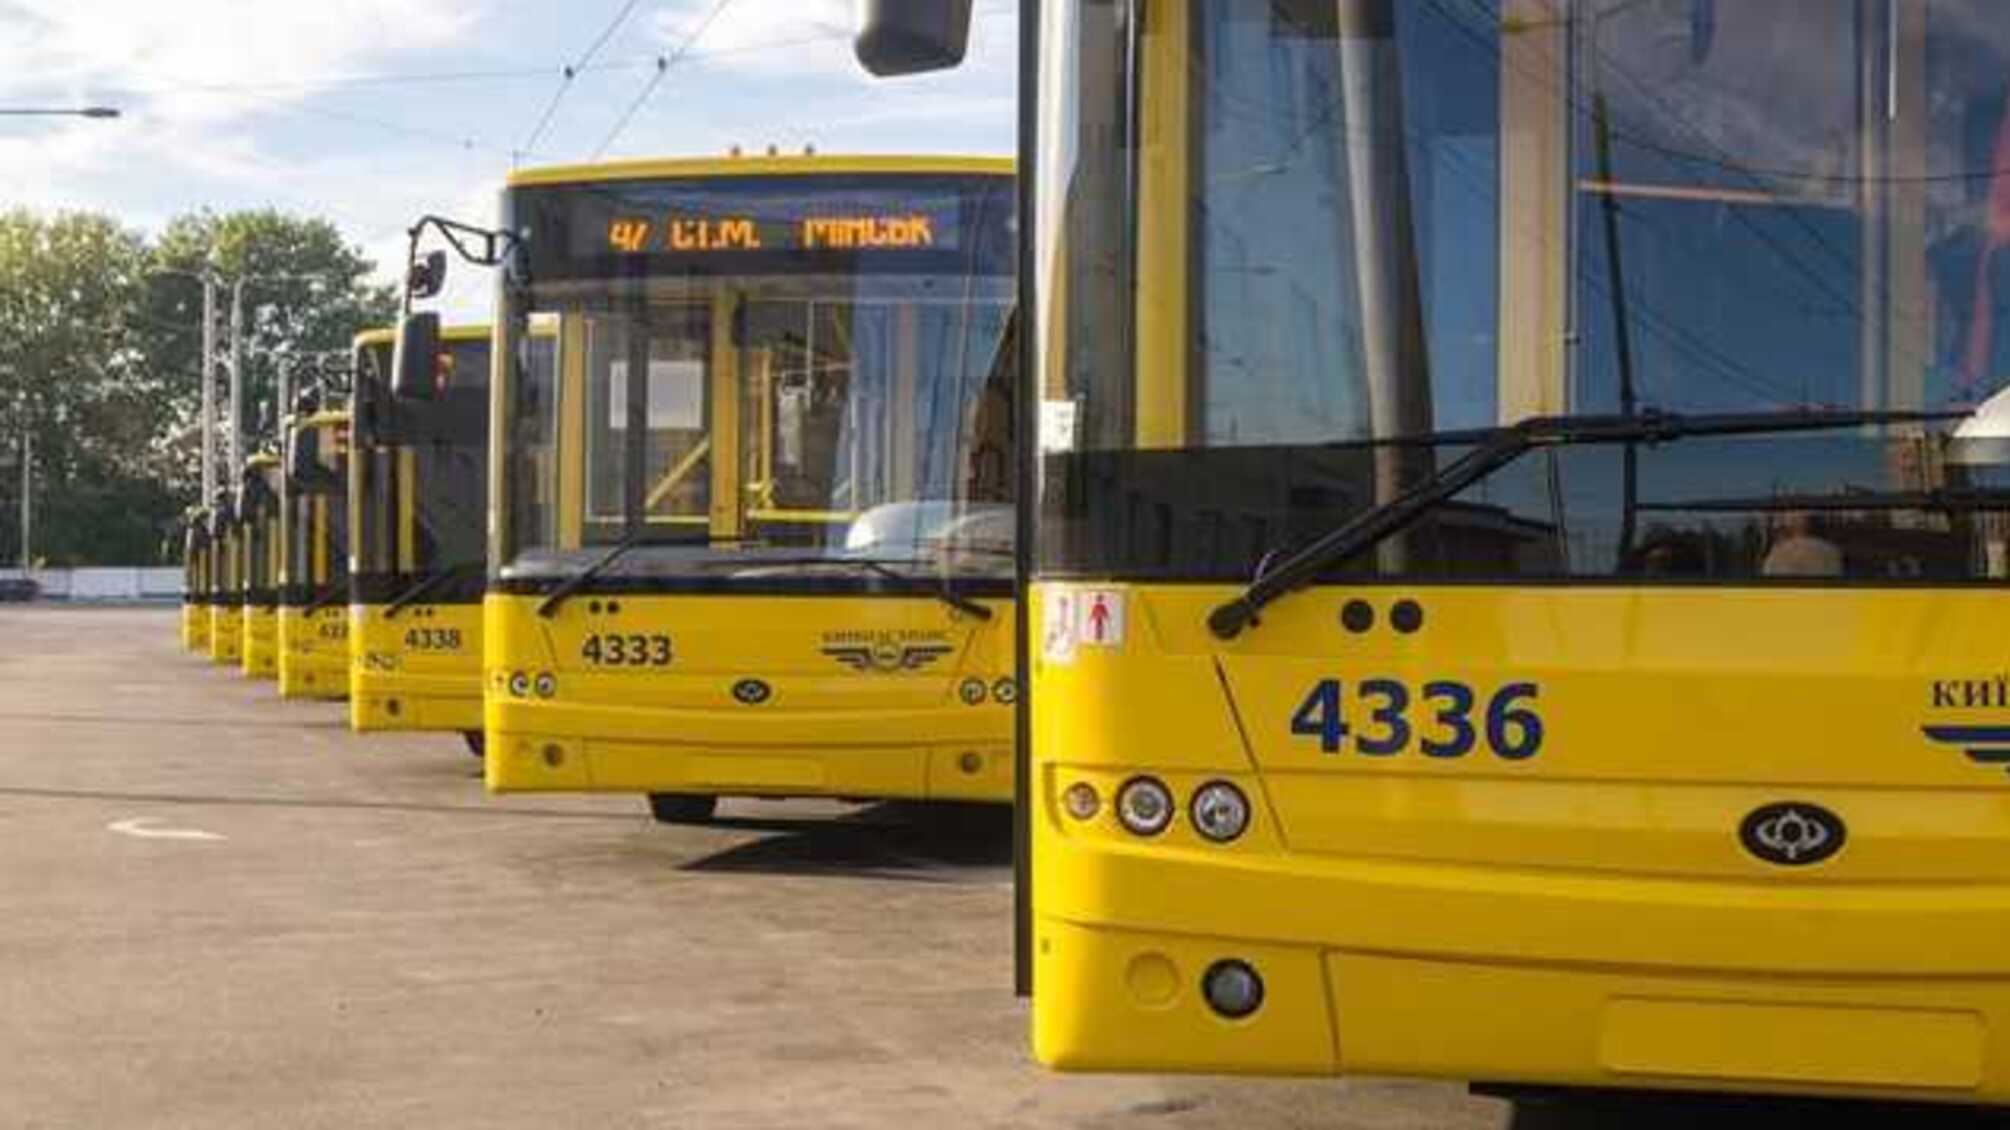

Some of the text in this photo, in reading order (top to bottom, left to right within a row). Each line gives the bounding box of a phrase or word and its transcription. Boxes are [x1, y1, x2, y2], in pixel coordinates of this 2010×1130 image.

[404, 628, 462, 649] 4338
[581, 633, 673, 666] 4333
[1290, 679, 1545, 760] 4336
